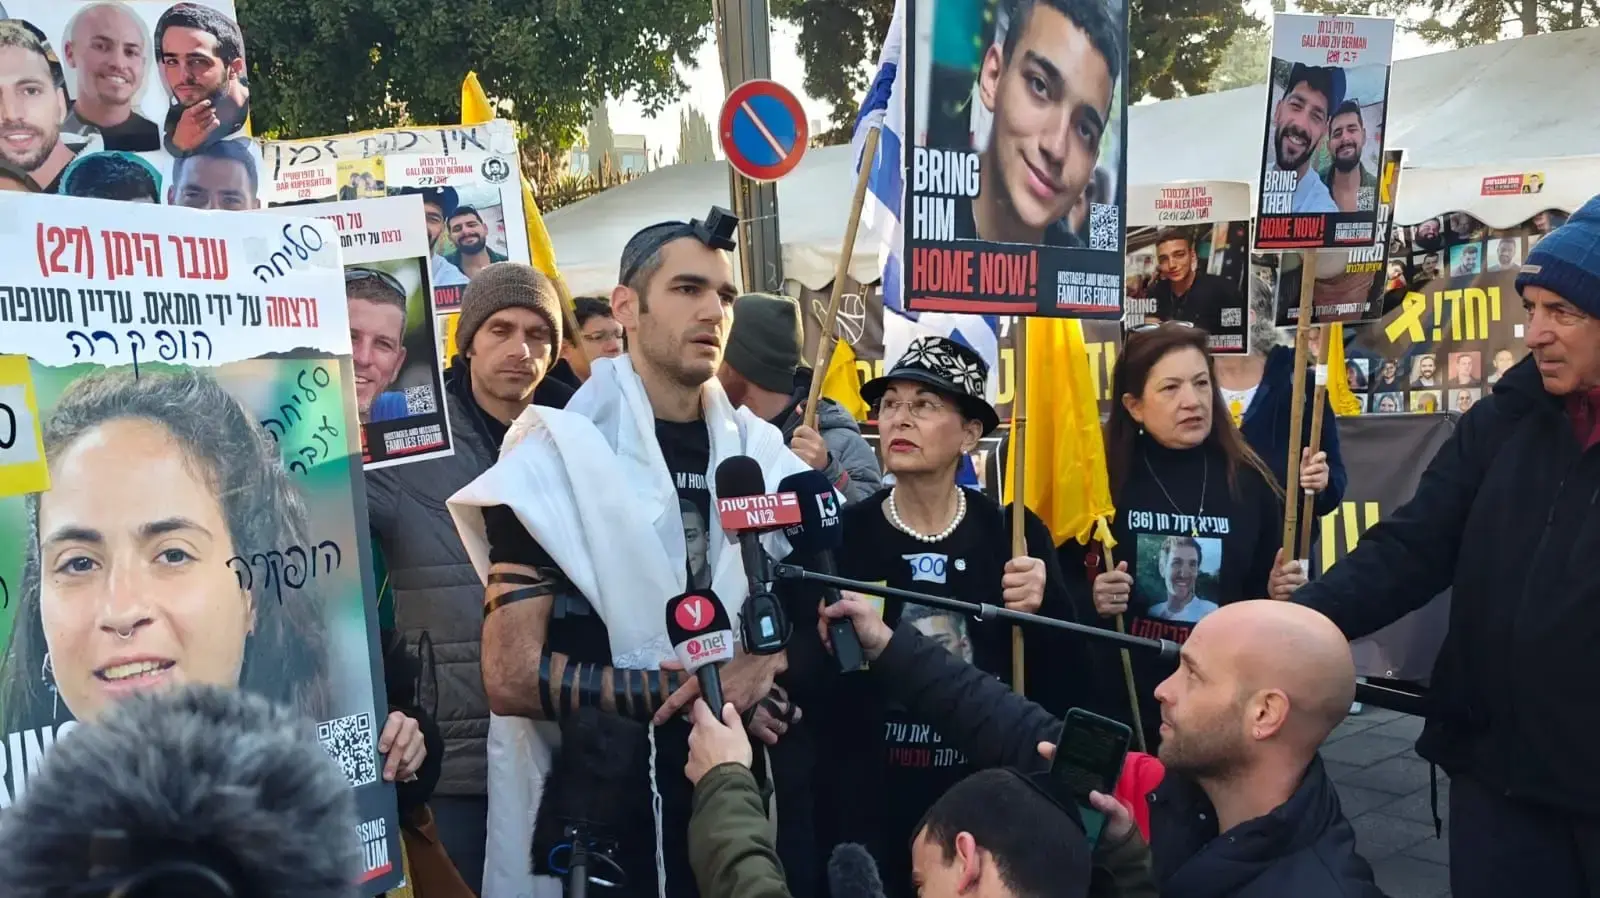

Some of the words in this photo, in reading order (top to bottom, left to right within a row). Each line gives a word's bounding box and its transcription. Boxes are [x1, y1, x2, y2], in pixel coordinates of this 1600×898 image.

[1317, 35, 1329, 47] AND
[1341, 36, 1367, 49] BERMAN
[912, 148, 980, 197] BRING
[1263, 170, 1298, 193] BRING
[1174, 197, 1212, 209] ALEXANDER
[1262, 193, 1292, 214] THEM
[346, 212, 363, 230] טל
[912, 196, 955, 241] HIM
[1259, 217, 1292, 239] HOME
[1293, 214, 1326, 239] NOW!
[353, 233, 367, 247] ידי
[367, 231, 380, 246] על
[380, 229, 402, 243] נרצח
[36, 222, 95, 280] (27)
[100, 230, 164, 281] הימן
[167, 234, 229, 281] ענבר
[911, 247, 974, 295] HOME
[979, 249, 1039, 298] NOW!
[0, 285, 74, 323] חטופה
[435, 286, 460, 305] OW!
[1057, 284, 1093, 306] FAMILIES
[1093, 286, 1120, 308] FORUM
[76, 288, 134, 328] עדיין
[207, 293, 234, 326] ידי
[236, 292, 262, 327] על
[265, 296, 320, 329] נרצחה
[720, 494, 778, 513] החדשות
[746, 508, 777, 526] N12
[1127, 509, 1154, 531] (36)
[1156, 512, 1169, 531] חן
[884, 722, 907, 742] עיד
[908, 723, 930, 743] את
